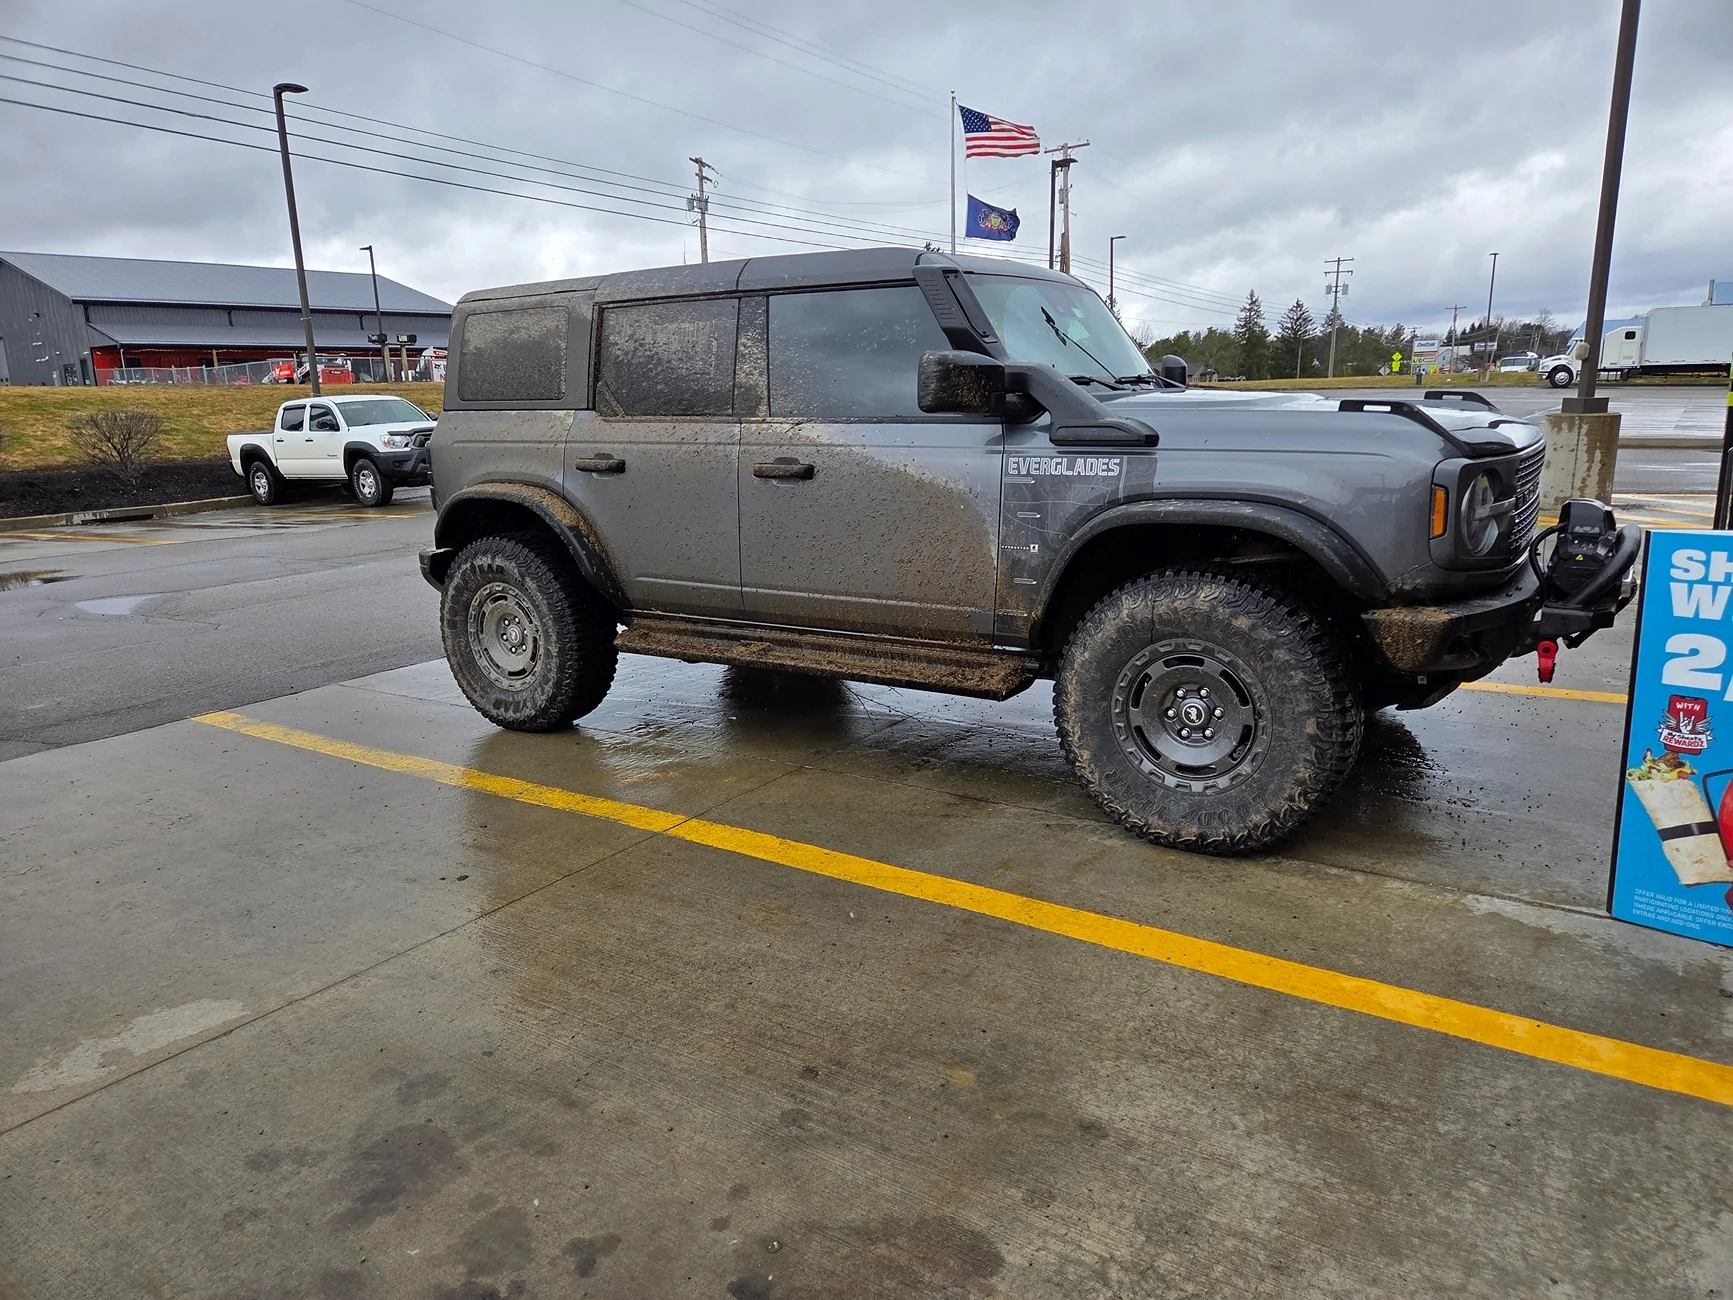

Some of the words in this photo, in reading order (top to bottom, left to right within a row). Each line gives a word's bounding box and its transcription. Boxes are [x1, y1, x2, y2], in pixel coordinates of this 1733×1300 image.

[1007, 457, 1121, 477] EVERGLADES
[1669, 581, 1733, 621] W
[1661, 633, 1733, 701] 2
[1675, 702, 1701, 712] WITH
[1662, 735, 1705, 748] REWARDZ
[1633, 895, 1679, 911] PARTICIPATING
[1679, 906, 1715, 919] LOCATIONS
[1634, 888, 1655, 898] OFFER
[1655, 893, 1673, 902] VALID
[1673, 897, 1687, 906] FOR
[1693, 902, 1719, 913] LIMITED
[1632, 908, 1656, 919] EXTRAS
[1656, 914, 1670, 923] AND
[1633, 901, 1655, 911] WHERE
[1695, 916, 1717, 927] OFFER
